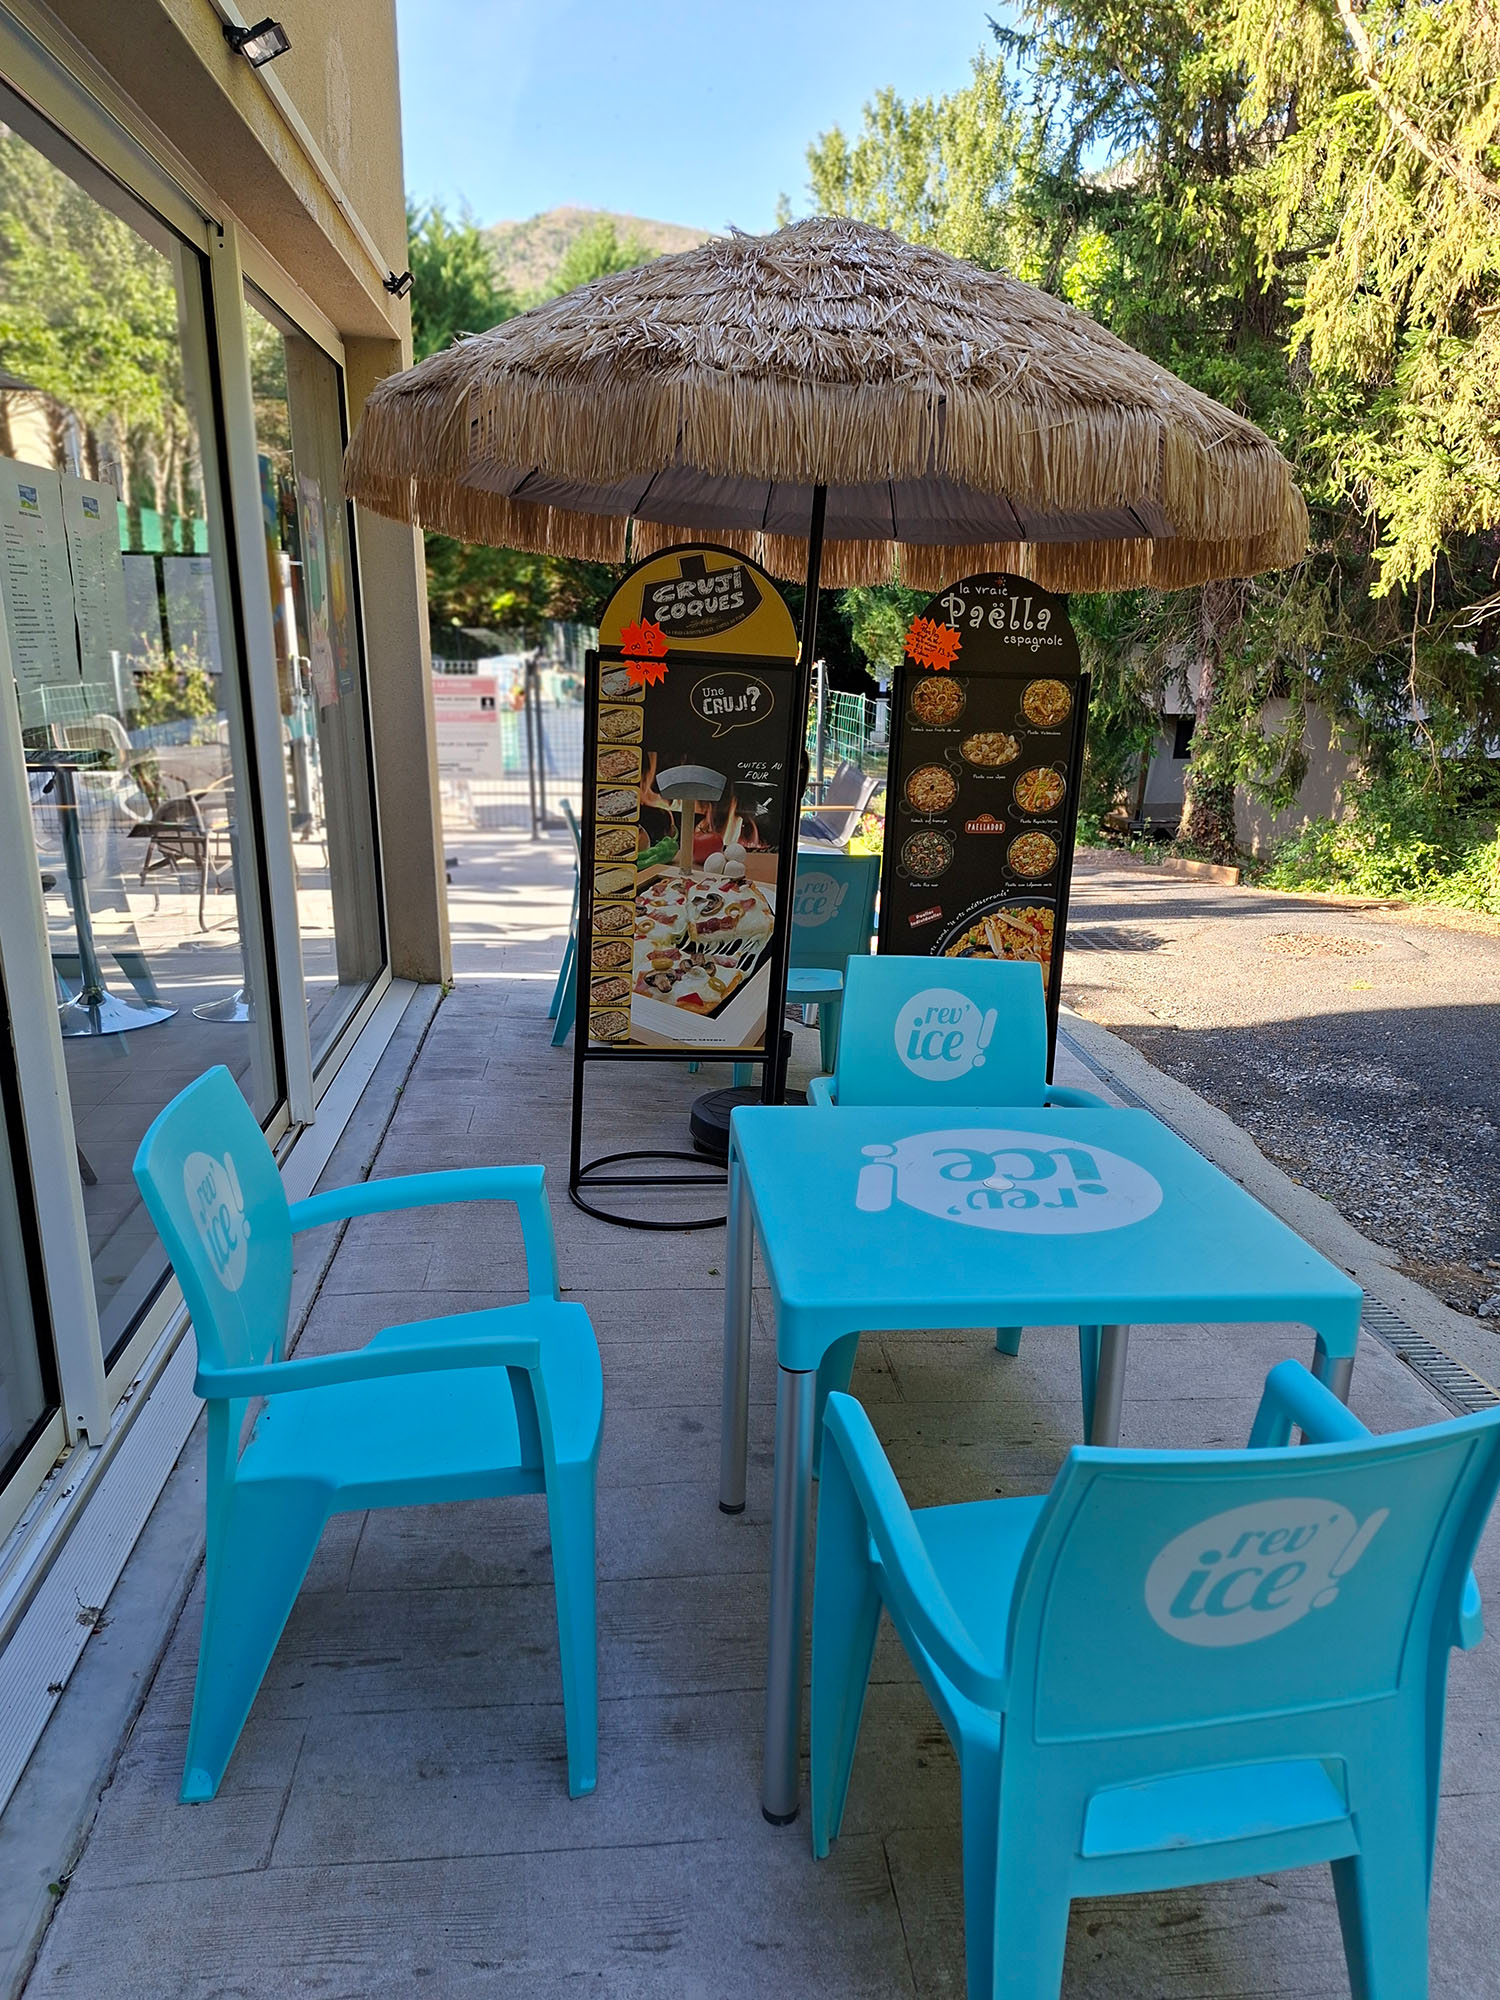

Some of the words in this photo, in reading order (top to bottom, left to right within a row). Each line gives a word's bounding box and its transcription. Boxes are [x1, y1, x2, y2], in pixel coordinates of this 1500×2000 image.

[960, 582, 970, 594] la
[975, 586, 1008, 596] vraie
[654, 591, 744, 622] COQUES
[940, 592, 1051, 631] Paëlla
[1003, 634, 1063, 653] espagnole
[702, 687, 725, 698] Une
[737, 761, 768, 770] CUITES
[771, 762, 783, 770] AU
[744, 770, 769, 780] FOUR
[967, 823, 1003, 831] PAELLADOR
[925, 1005, 971, 1024] rev'
[1226, 1514, 1339, 1559] rev'
